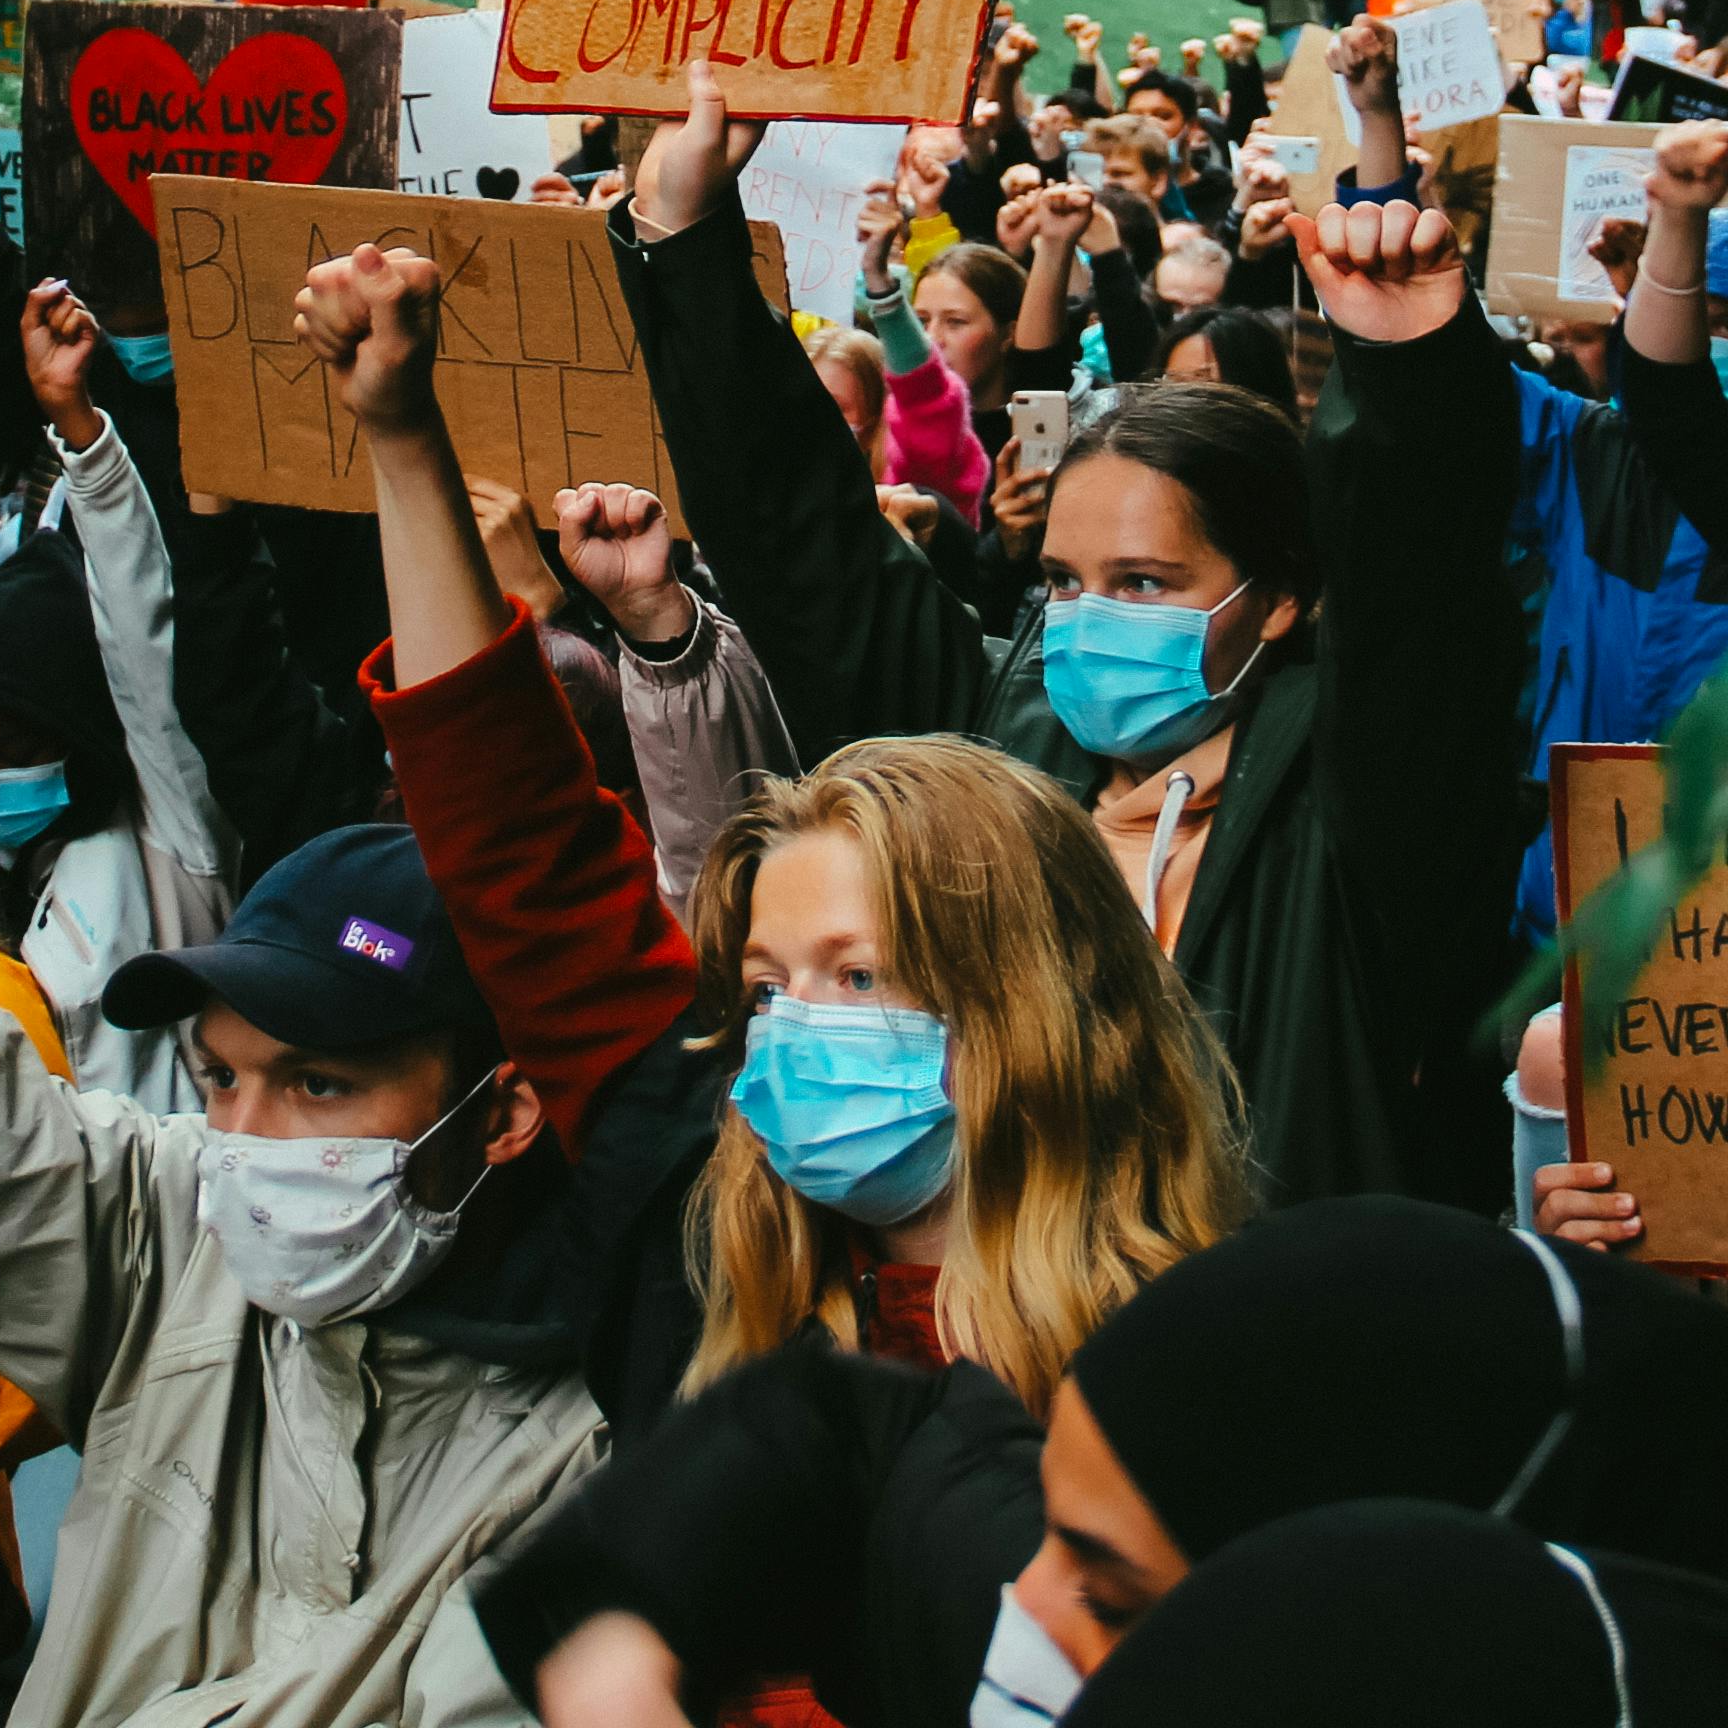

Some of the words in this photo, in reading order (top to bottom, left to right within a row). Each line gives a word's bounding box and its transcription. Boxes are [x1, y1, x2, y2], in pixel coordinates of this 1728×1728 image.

[88, 86, 206, 136] BLACK
[220, 89, 337, 138] LIVES
[128, 147, 273, 183] MATTER
[1583, 171, 1621, 189] ONE
